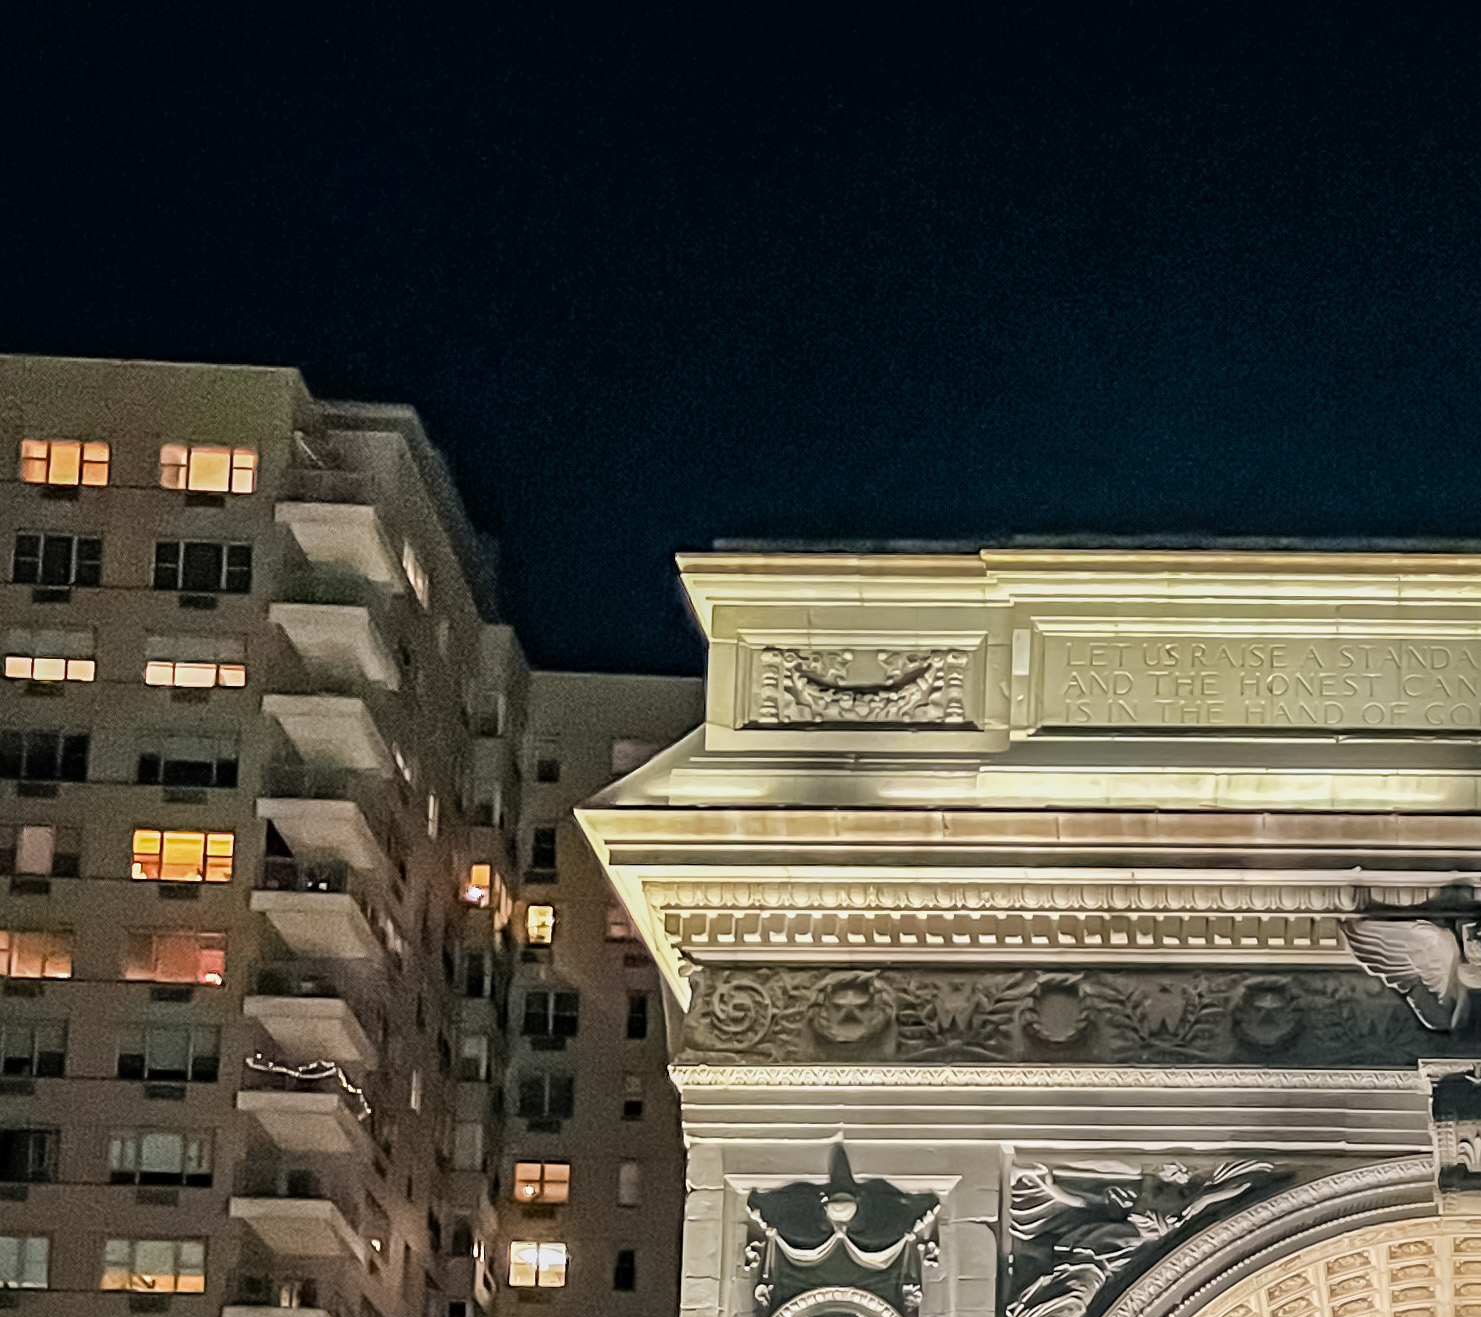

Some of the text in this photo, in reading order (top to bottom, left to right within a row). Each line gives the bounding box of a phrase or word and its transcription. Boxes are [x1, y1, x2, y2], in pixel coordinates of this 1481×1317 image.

[1065, 642, 1133, 667] LET
[1142, 642, 1180, 668] US
[1190, 643, 1288, 668] RAISE
[1302, 644, 1324, 669] A
[1064, 670, 1134, 696] AND
[1146, 670, 1220, 696] THE
[1240, 672, 1383, 697] HONEST
[1402, 673, 1478, 698] CAN
[1064, 699, 1094, 723] IS
[1106, 699, 1138, 723] IN
[1152, 699, 1226, 724] THE
[1244, 700, 1345, 725] HAND
[1362, 701, 1409, 726] OF
